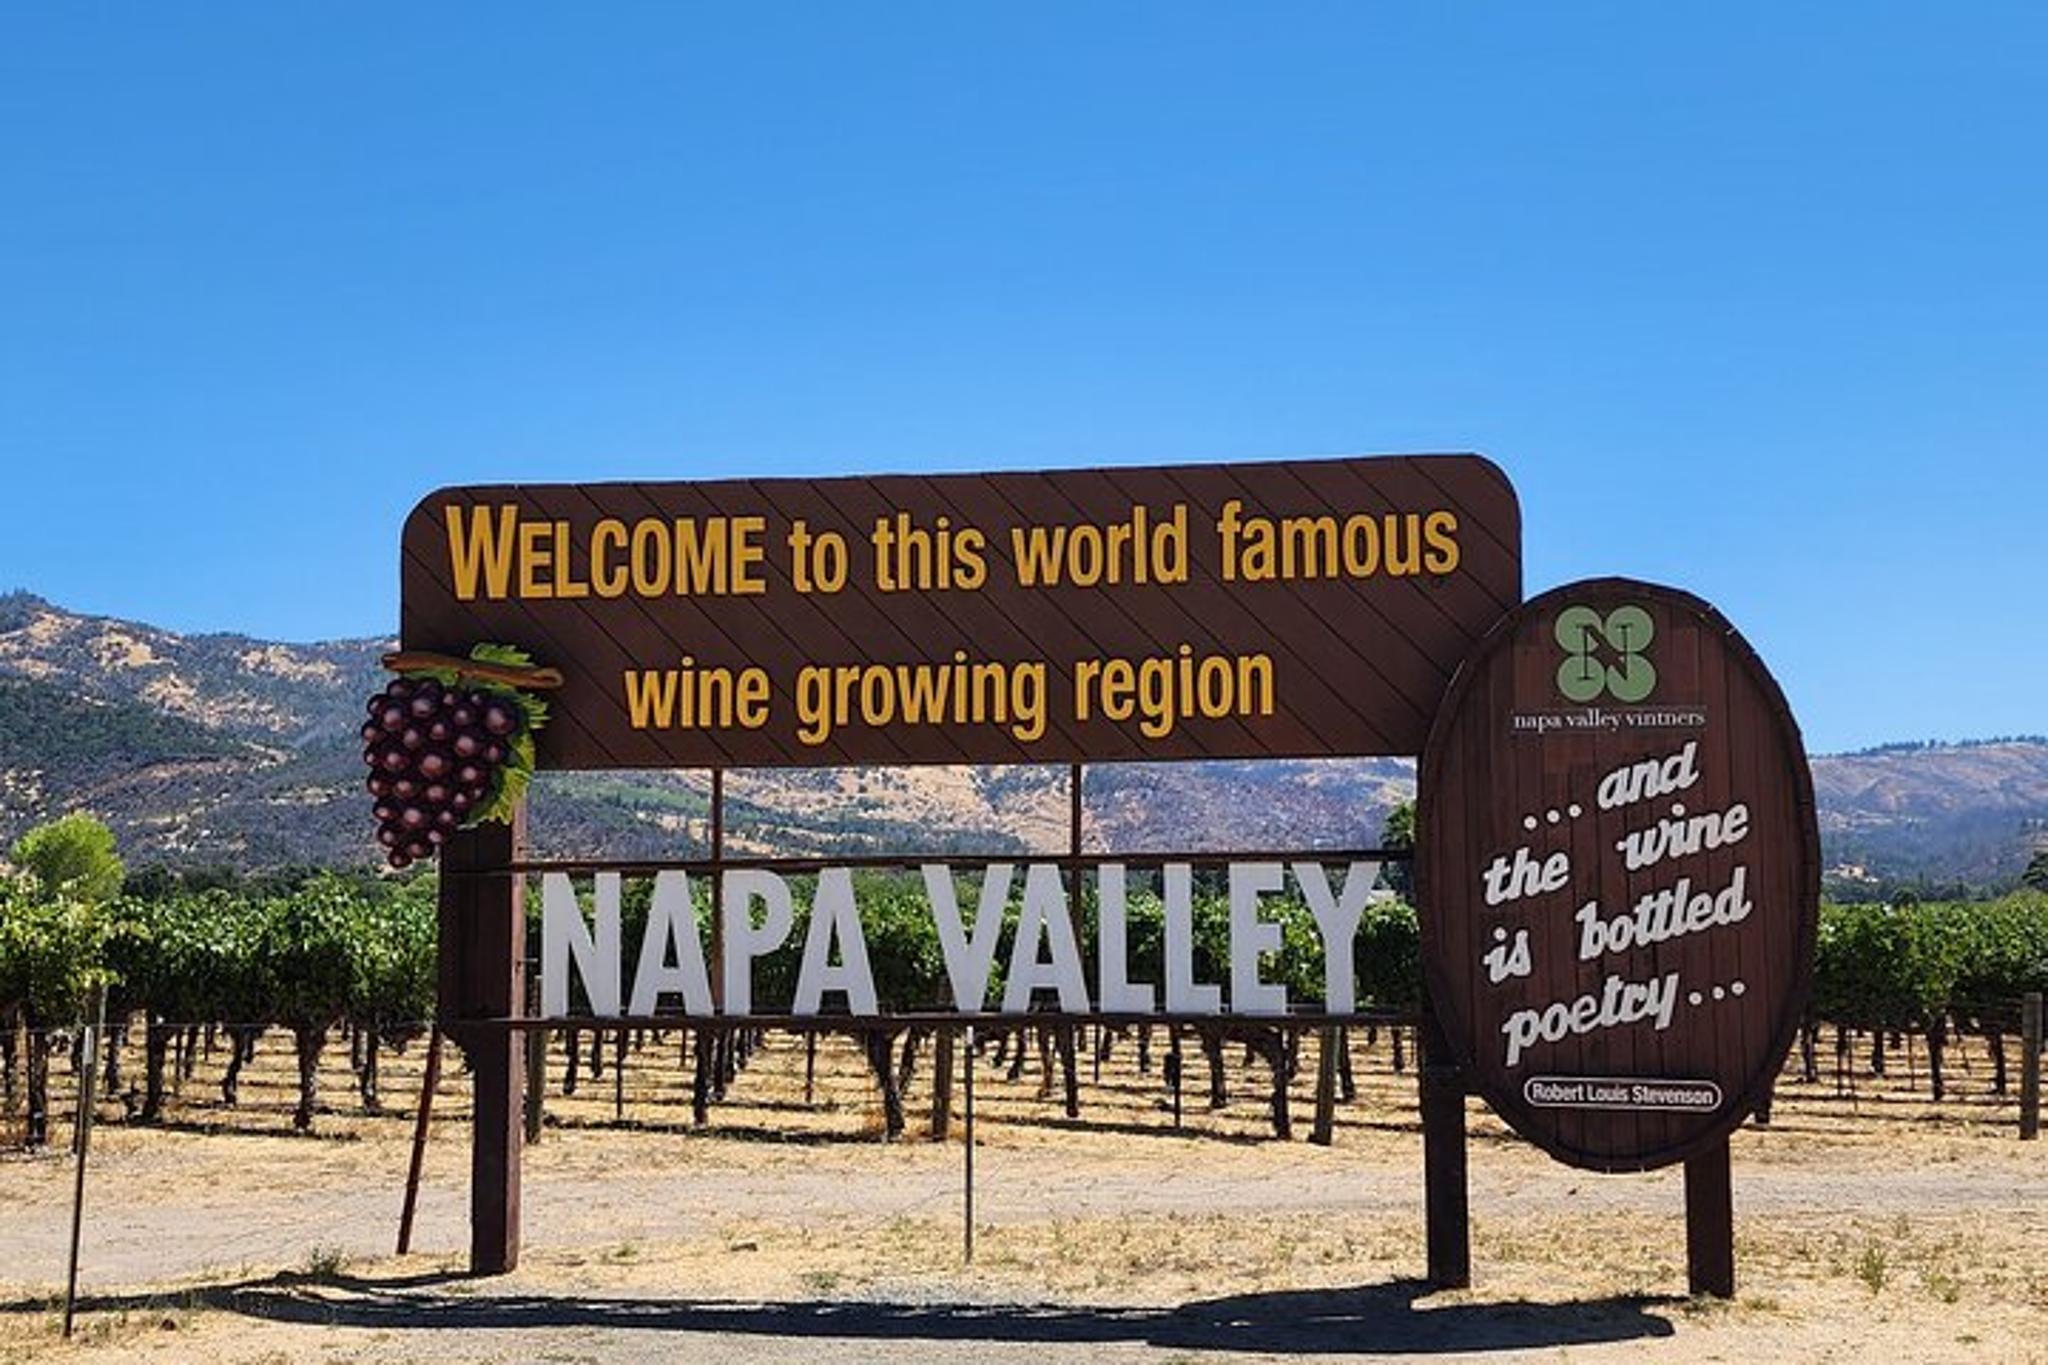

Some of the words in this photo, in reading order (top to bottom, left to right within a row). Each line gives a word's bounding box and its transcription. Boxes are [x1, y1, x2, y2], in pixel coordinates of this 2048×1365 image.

[445, 504, 767, 600] WELCOME
[788, 519, 849, 594] to
[873, 512, 987, 591] this
[1011, 504, 1188, 586] world
[1217, 500, 1460, 581] famous
[624, 655, 770, 729] wine
[796, 649, 1048, 744] growing
[1075, 643, 1275, 738] region
[1514, 713, 1562, 733] napa
[1565, 707, 1620, 731] valley
[1626, 708, 1706, 727] vintners
[1484, 847, 1569, 905] the
[1616, 803, 1749, 871] wine
[541, 868, 879, 1017] NAPA
[920, 861, 1381, 1016] VALLEY
[1483, 928, 1532, 984] is
[1576, 866, 1752, 960] bottled
[1531, 1081, 1584, 1103] Robert
[1586, 1084, 1629, 1105] Louis
[1632, 1085, 1715, 1106] Stevenson
